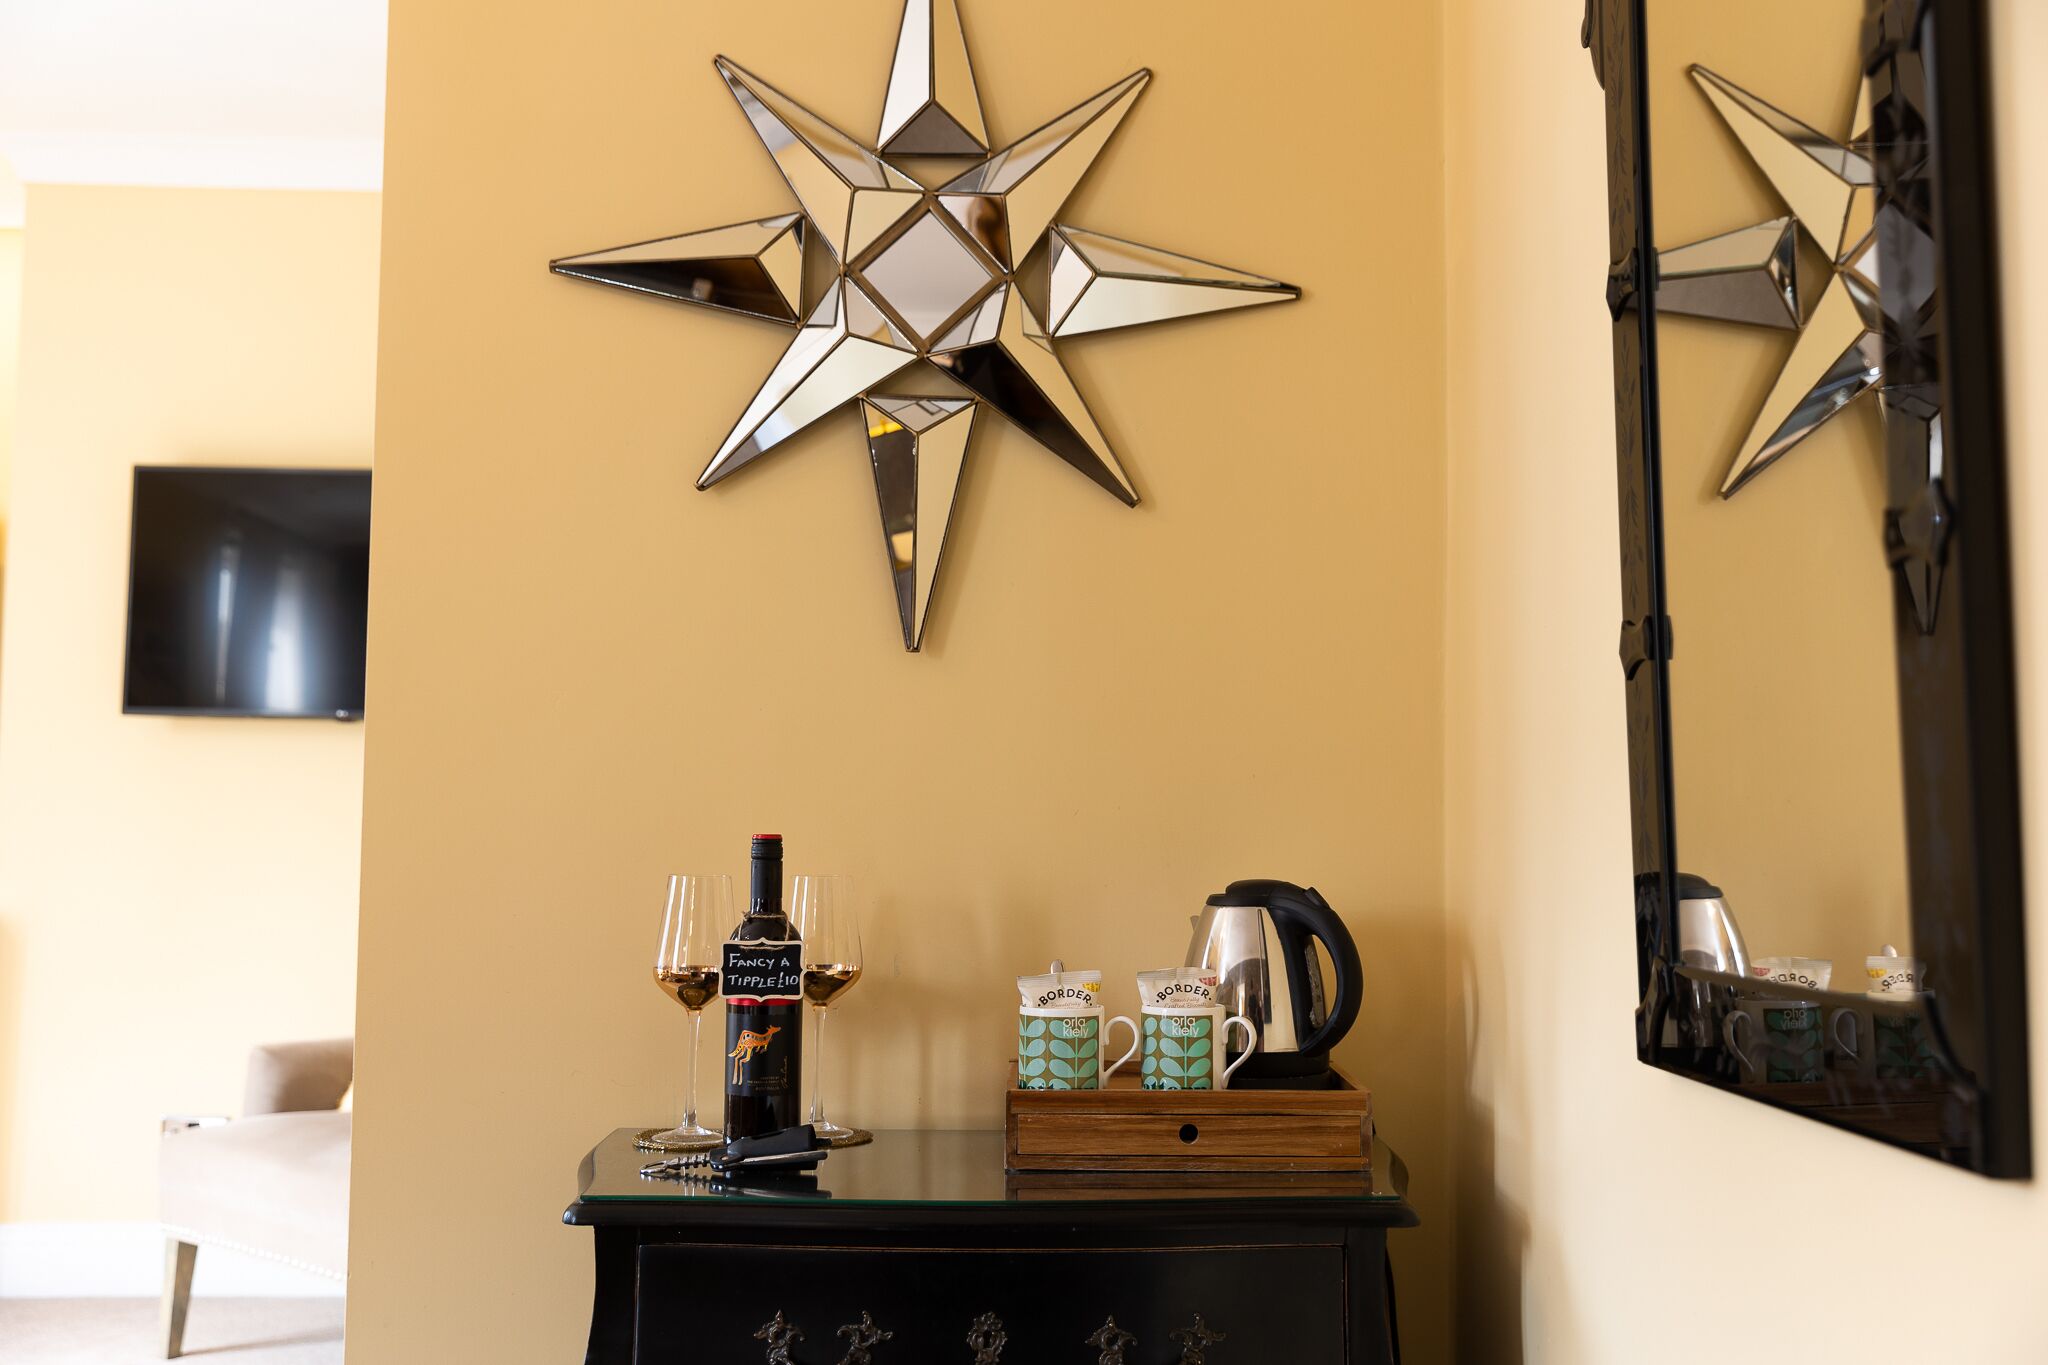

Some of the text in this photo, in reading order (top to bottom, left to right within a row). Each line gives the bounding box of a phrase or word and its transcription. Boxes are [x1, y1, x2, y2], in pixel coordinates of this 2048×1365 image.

[729, 953, 790, 970] FANCY A
[727, 971, 799, 988] TIPPLE £10
[1063, 1017, 1086, 1028] orla
[1172, 1016, 1196, 1026] orla
[1063, 1026, 1089, 1038] kiely
[1172, 1025, 1199, 1037] kiely
